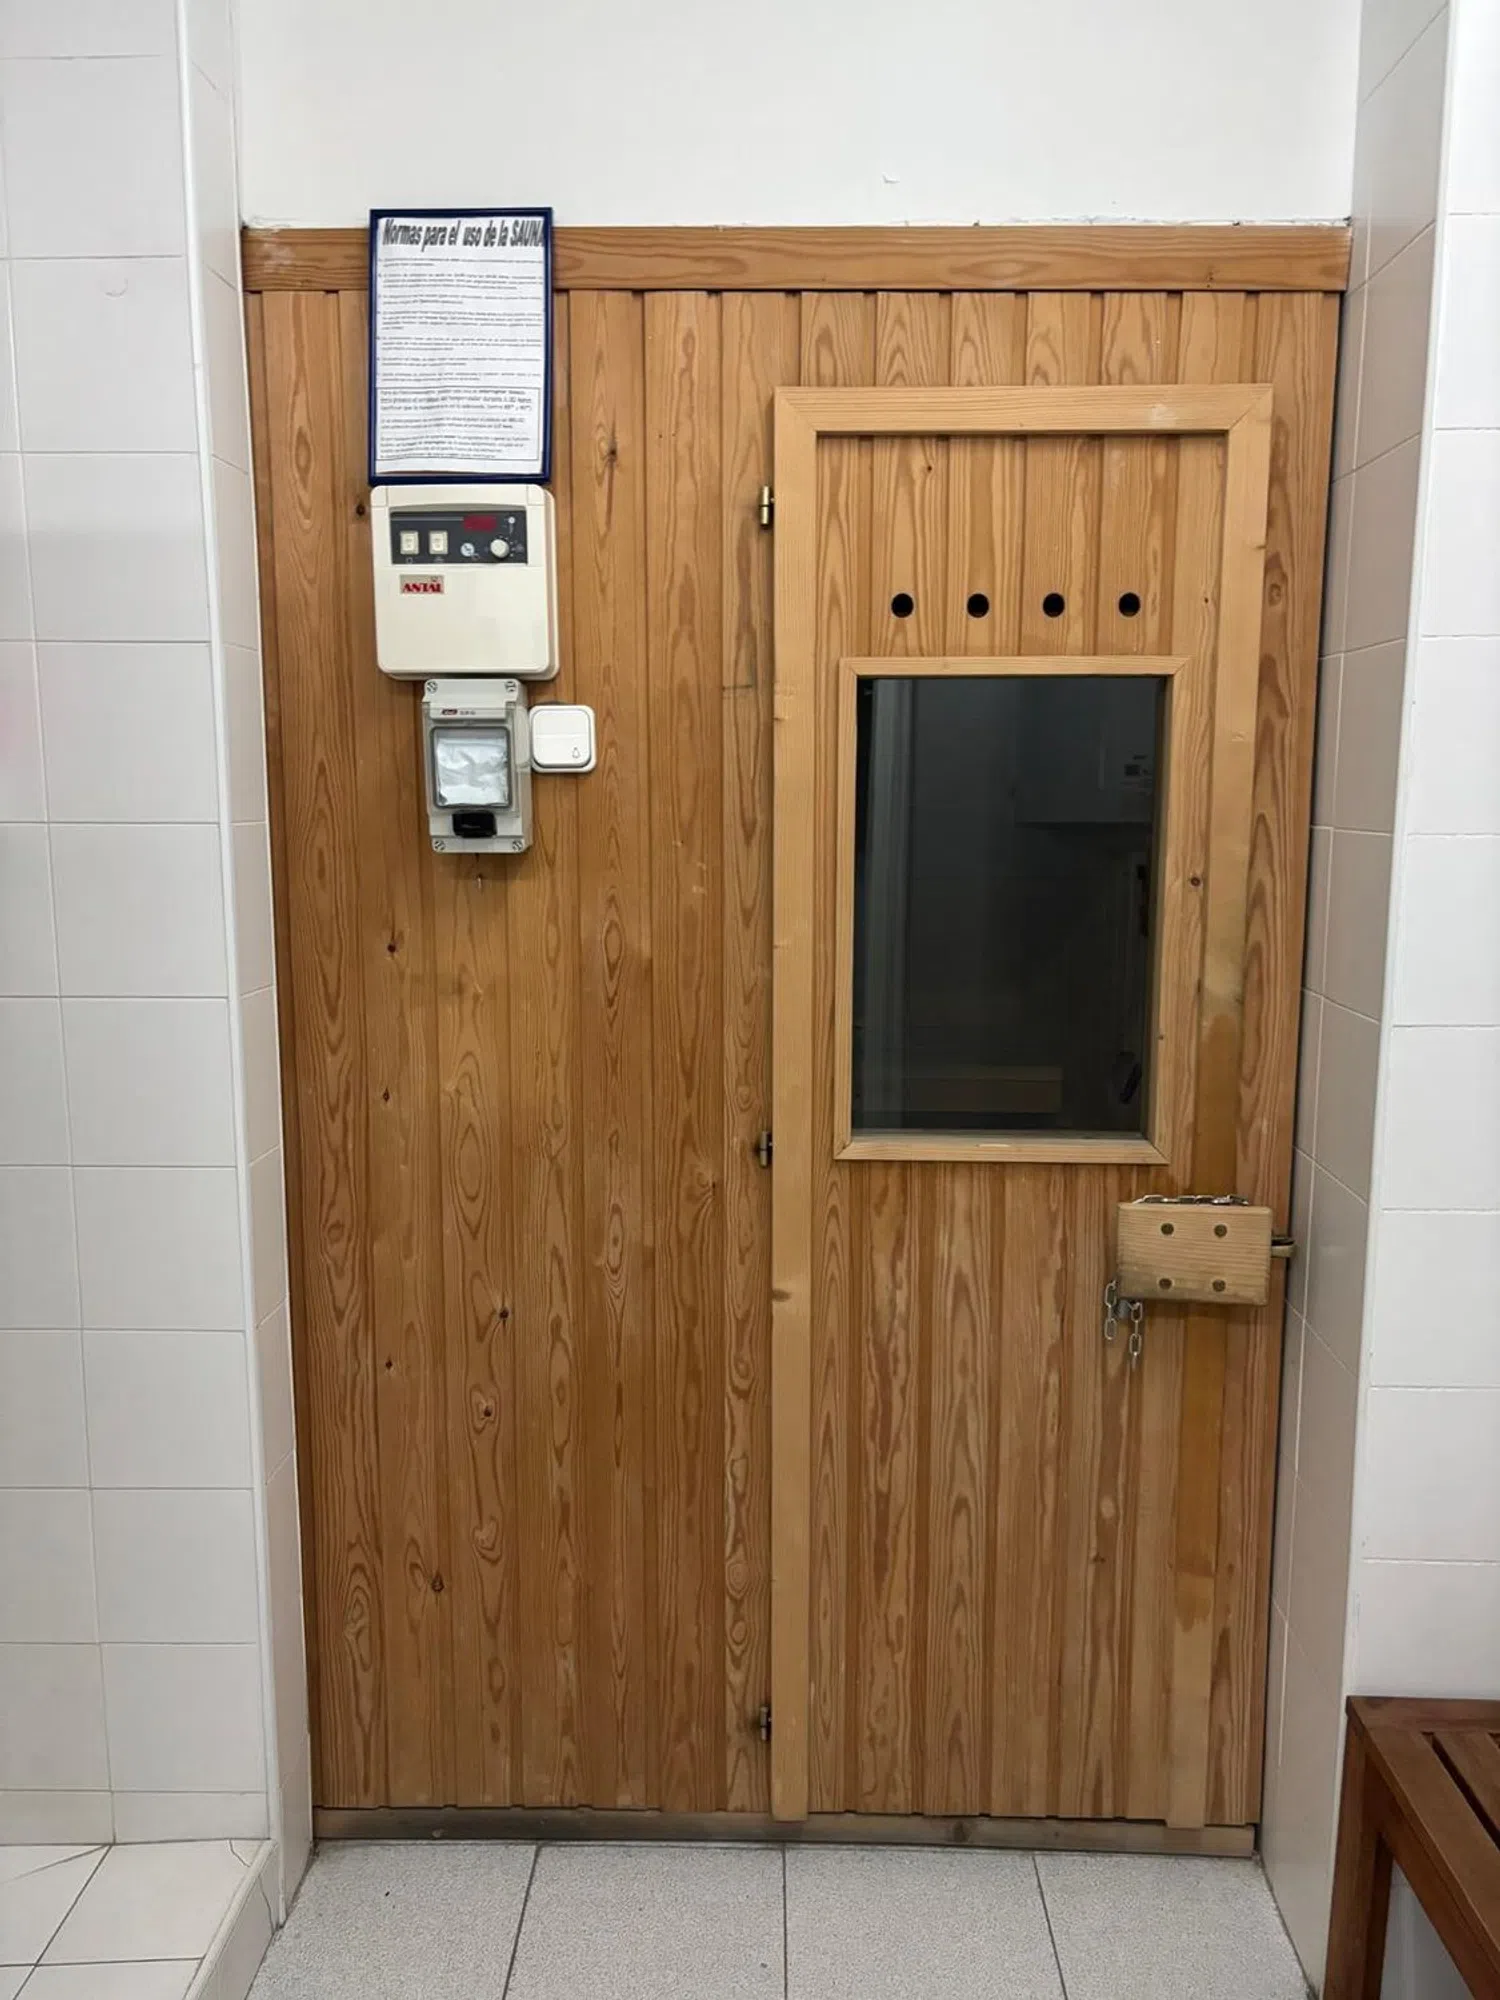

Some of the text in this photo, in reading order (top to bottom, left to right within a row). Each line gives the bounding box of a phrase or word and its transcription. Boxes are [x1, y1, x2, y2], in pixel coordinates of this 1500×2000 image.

[382, 219, 422, 246] Normas
[420, 226, 447, 252] para
[448, 220, 461, 246] el
[463, 226, 483, 247] uso
[484, 220, 497, 247] de
[497, 220, 509, 247] la
